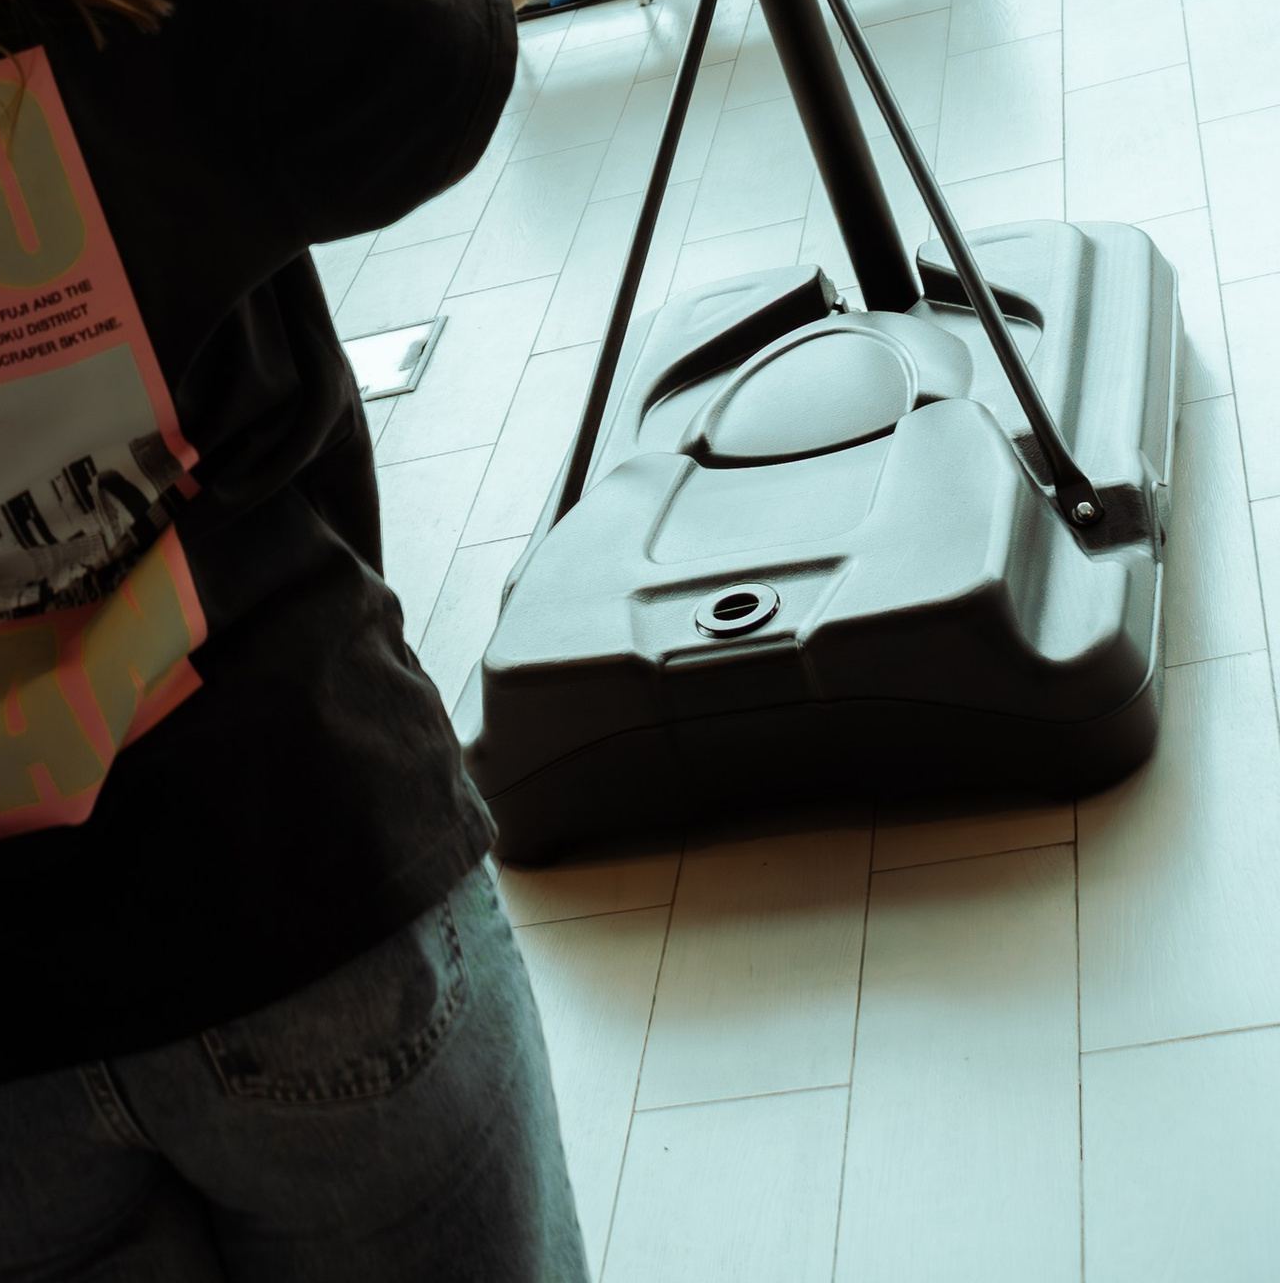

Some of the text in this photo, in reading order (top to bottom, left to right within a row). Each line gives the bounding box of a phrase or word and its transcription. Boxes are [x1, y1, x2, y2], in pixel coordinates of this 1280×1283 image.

[0, 303, 29, 323] FUJI
[33, 291, 62, 312] AND
[64, 279, 93, 299] THE
[26, 303, 88, 336] DISTRICT
